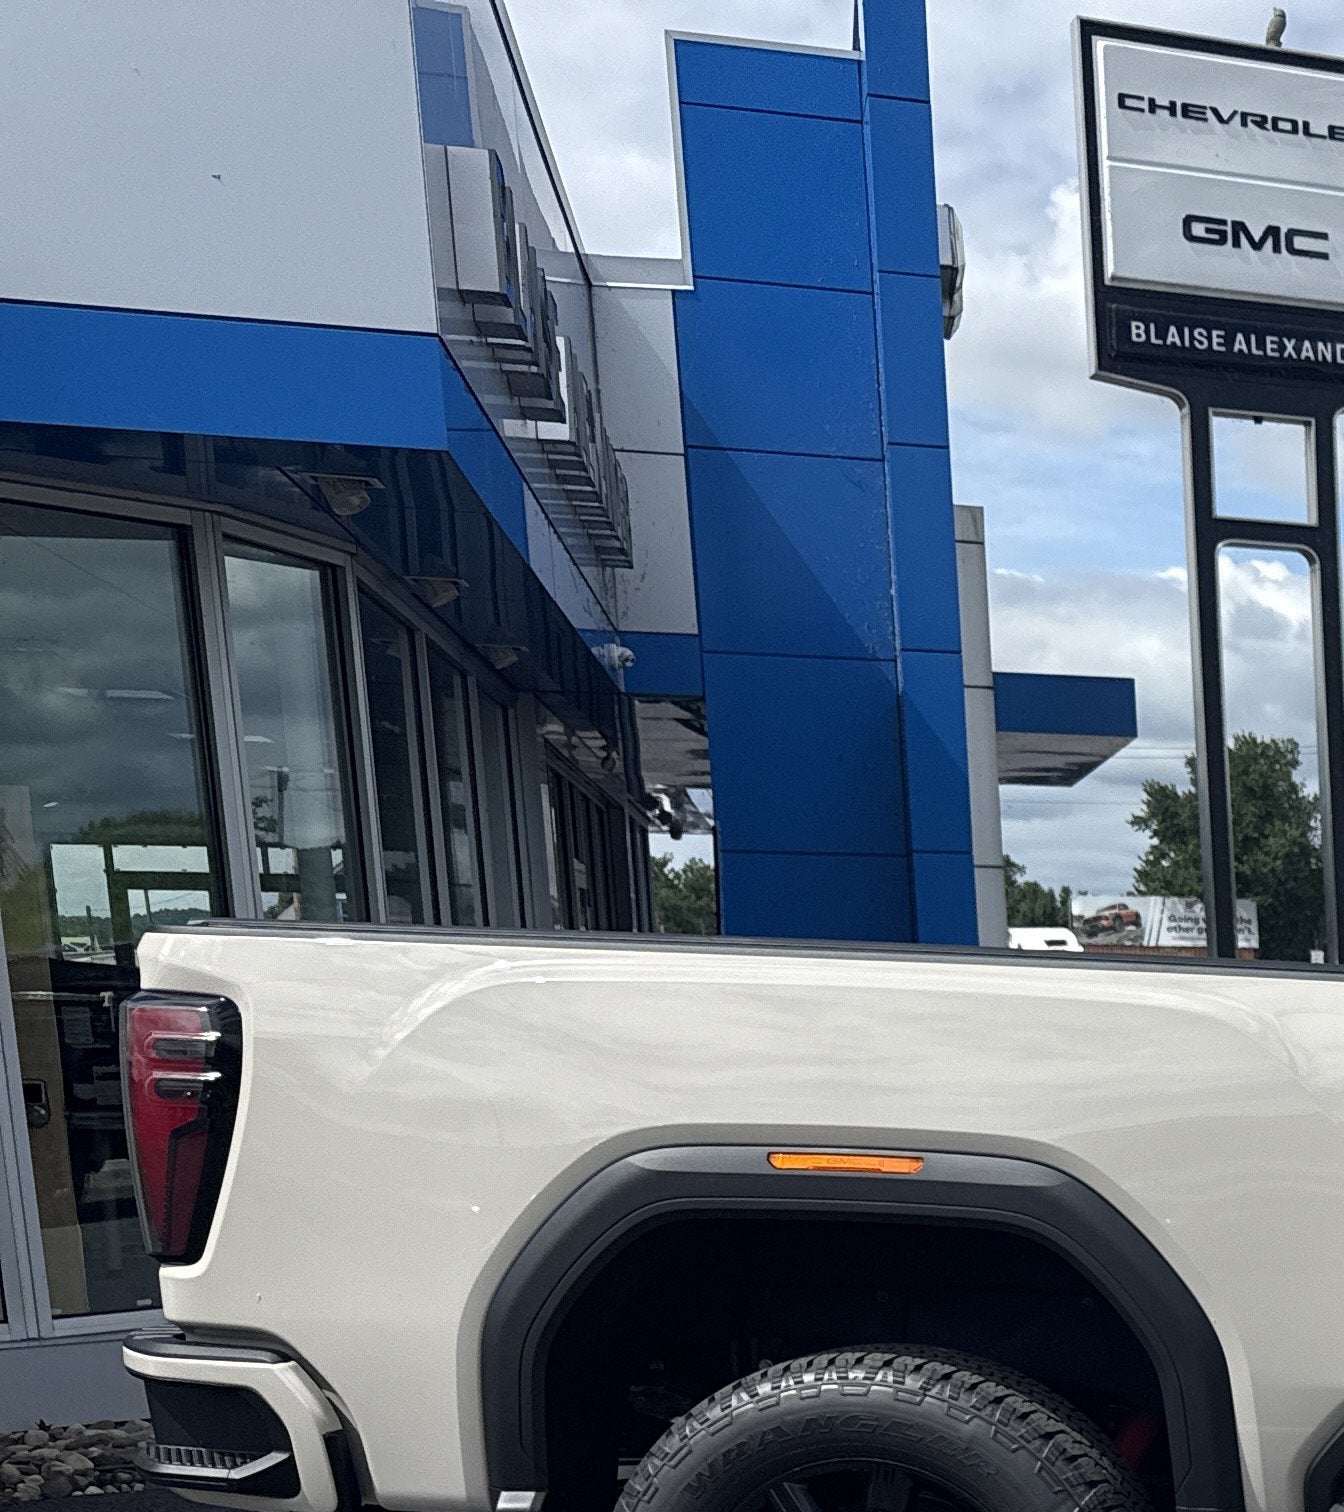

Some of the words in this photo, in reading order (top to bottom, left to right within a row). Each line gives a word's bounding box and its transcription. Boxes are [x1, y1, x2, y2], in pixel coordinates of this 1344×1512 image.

[1182, 214, 1329, 260] GMC
[1130, 321, 1226, 353] BLAISE
[680, 1413, 1000, 1501] WRANGLER
